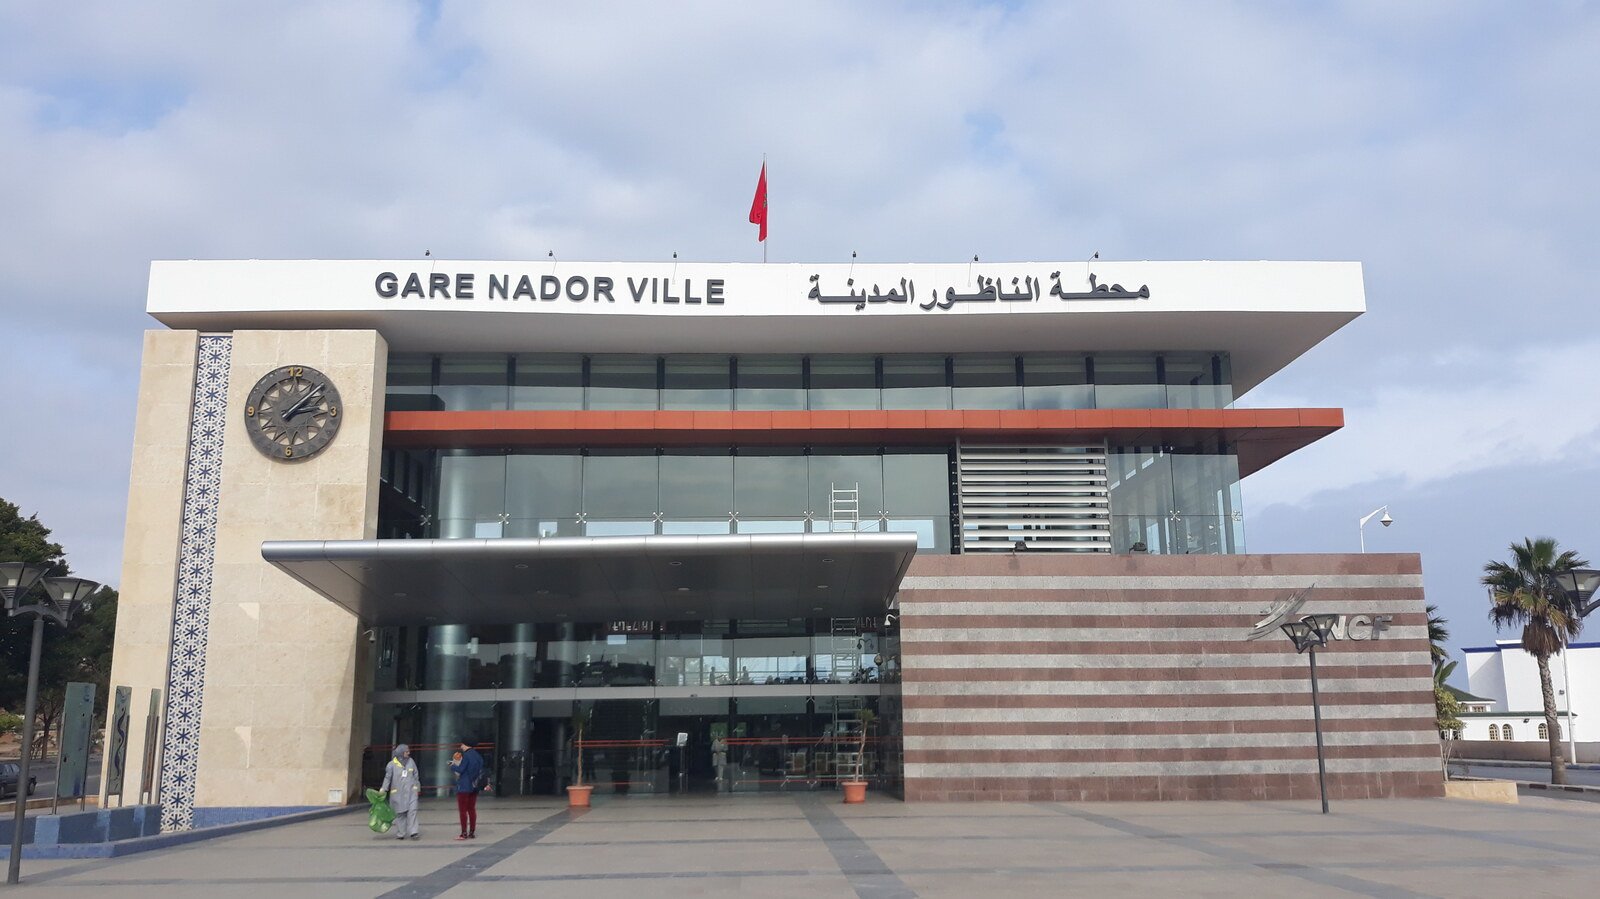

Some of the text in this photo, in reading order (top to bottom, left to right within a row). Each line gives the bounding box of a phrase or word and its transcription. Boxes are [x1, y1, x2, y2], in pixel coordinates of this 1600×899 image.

[375, 272, 724, 304] GARE NADOR VILLE
[808, 271, 1150, 311] محطة الناظور المدينة
[288, 366, 303, 377] 12
[247, 406, 255, 416] 9
[330, 406, 338, 416] 3
[285, 446, 292, 456] 6
[1299, 614, 1393, 640] NCF
